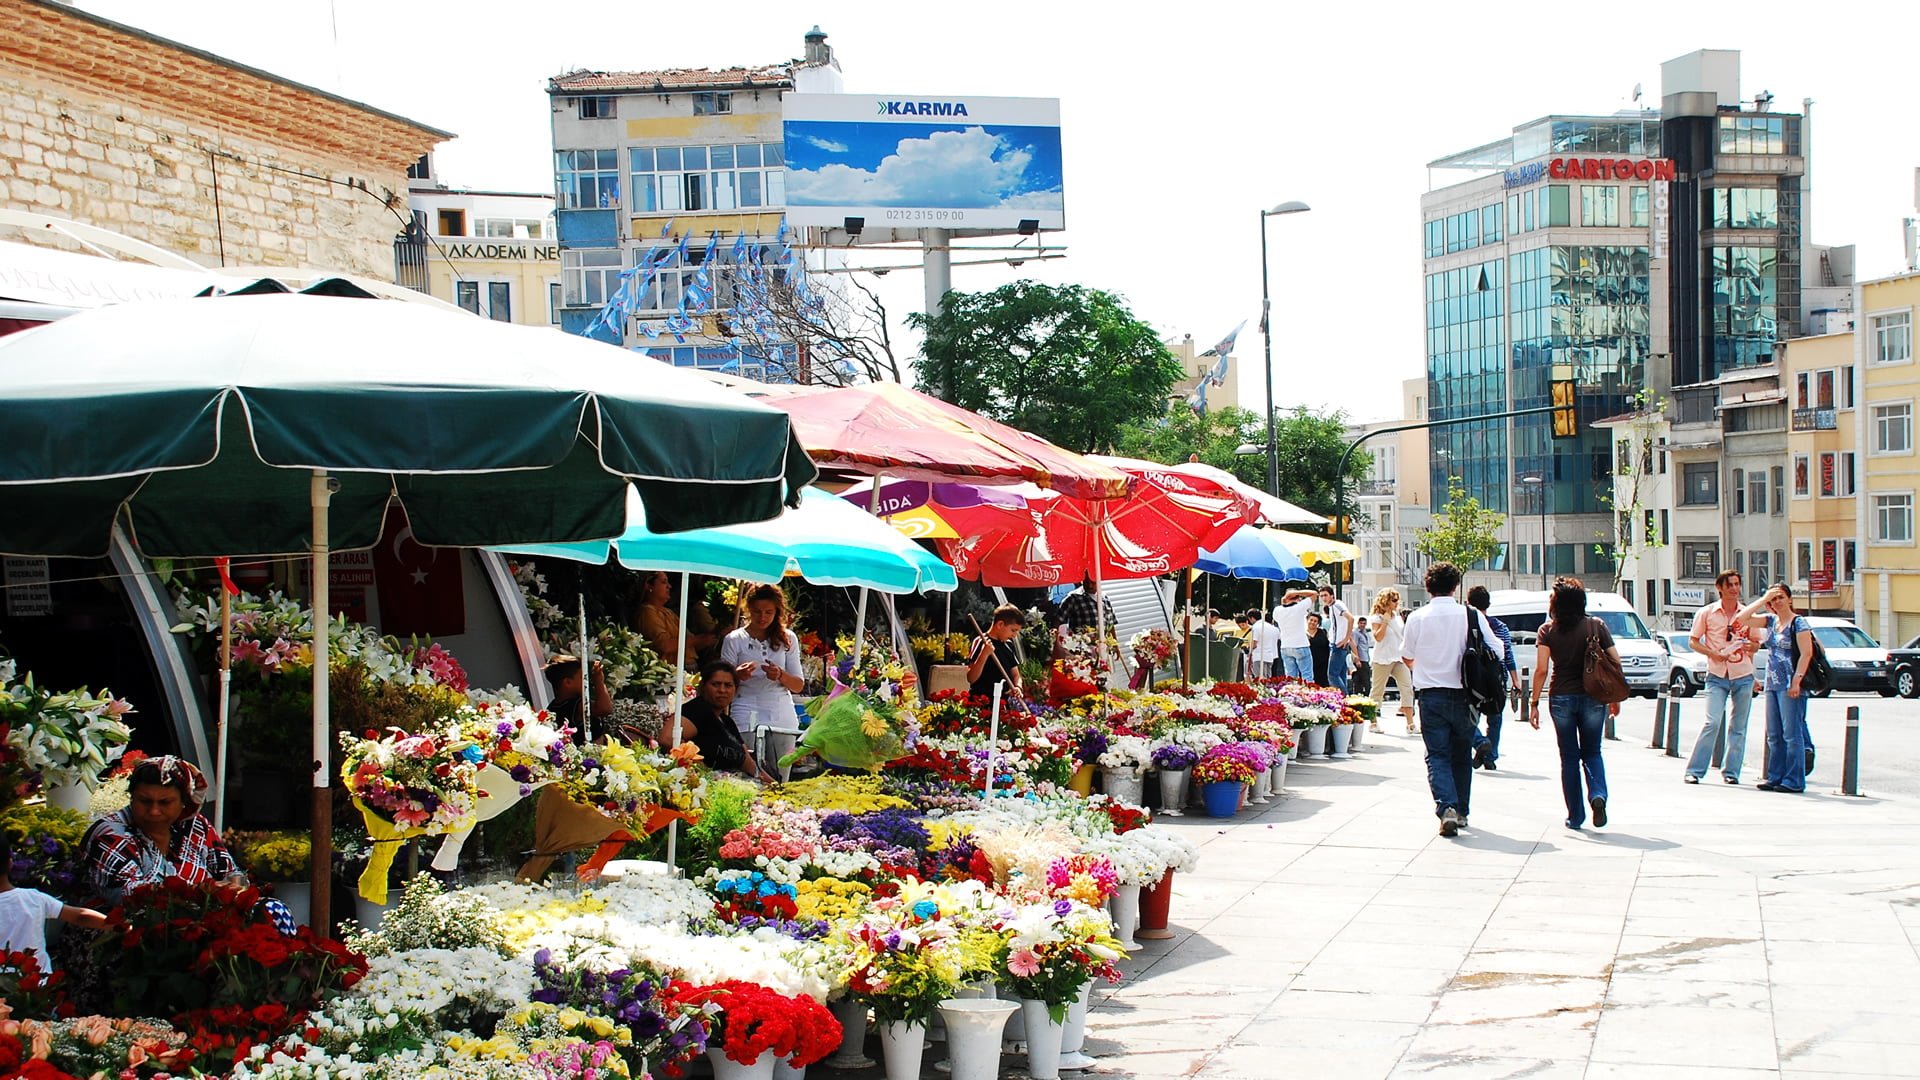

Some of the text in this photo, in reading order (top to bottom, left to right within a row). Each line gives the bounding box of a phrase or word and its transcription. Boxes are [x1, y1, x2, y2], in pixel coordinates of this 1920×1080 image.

[888, 102, 968, 116] KARMA
[1549, 158, 1676, 180] CARTOON
[886, 210, 964, 220] 0212 315 09 00
[1655, 181, 1669, 259] HOTEL
